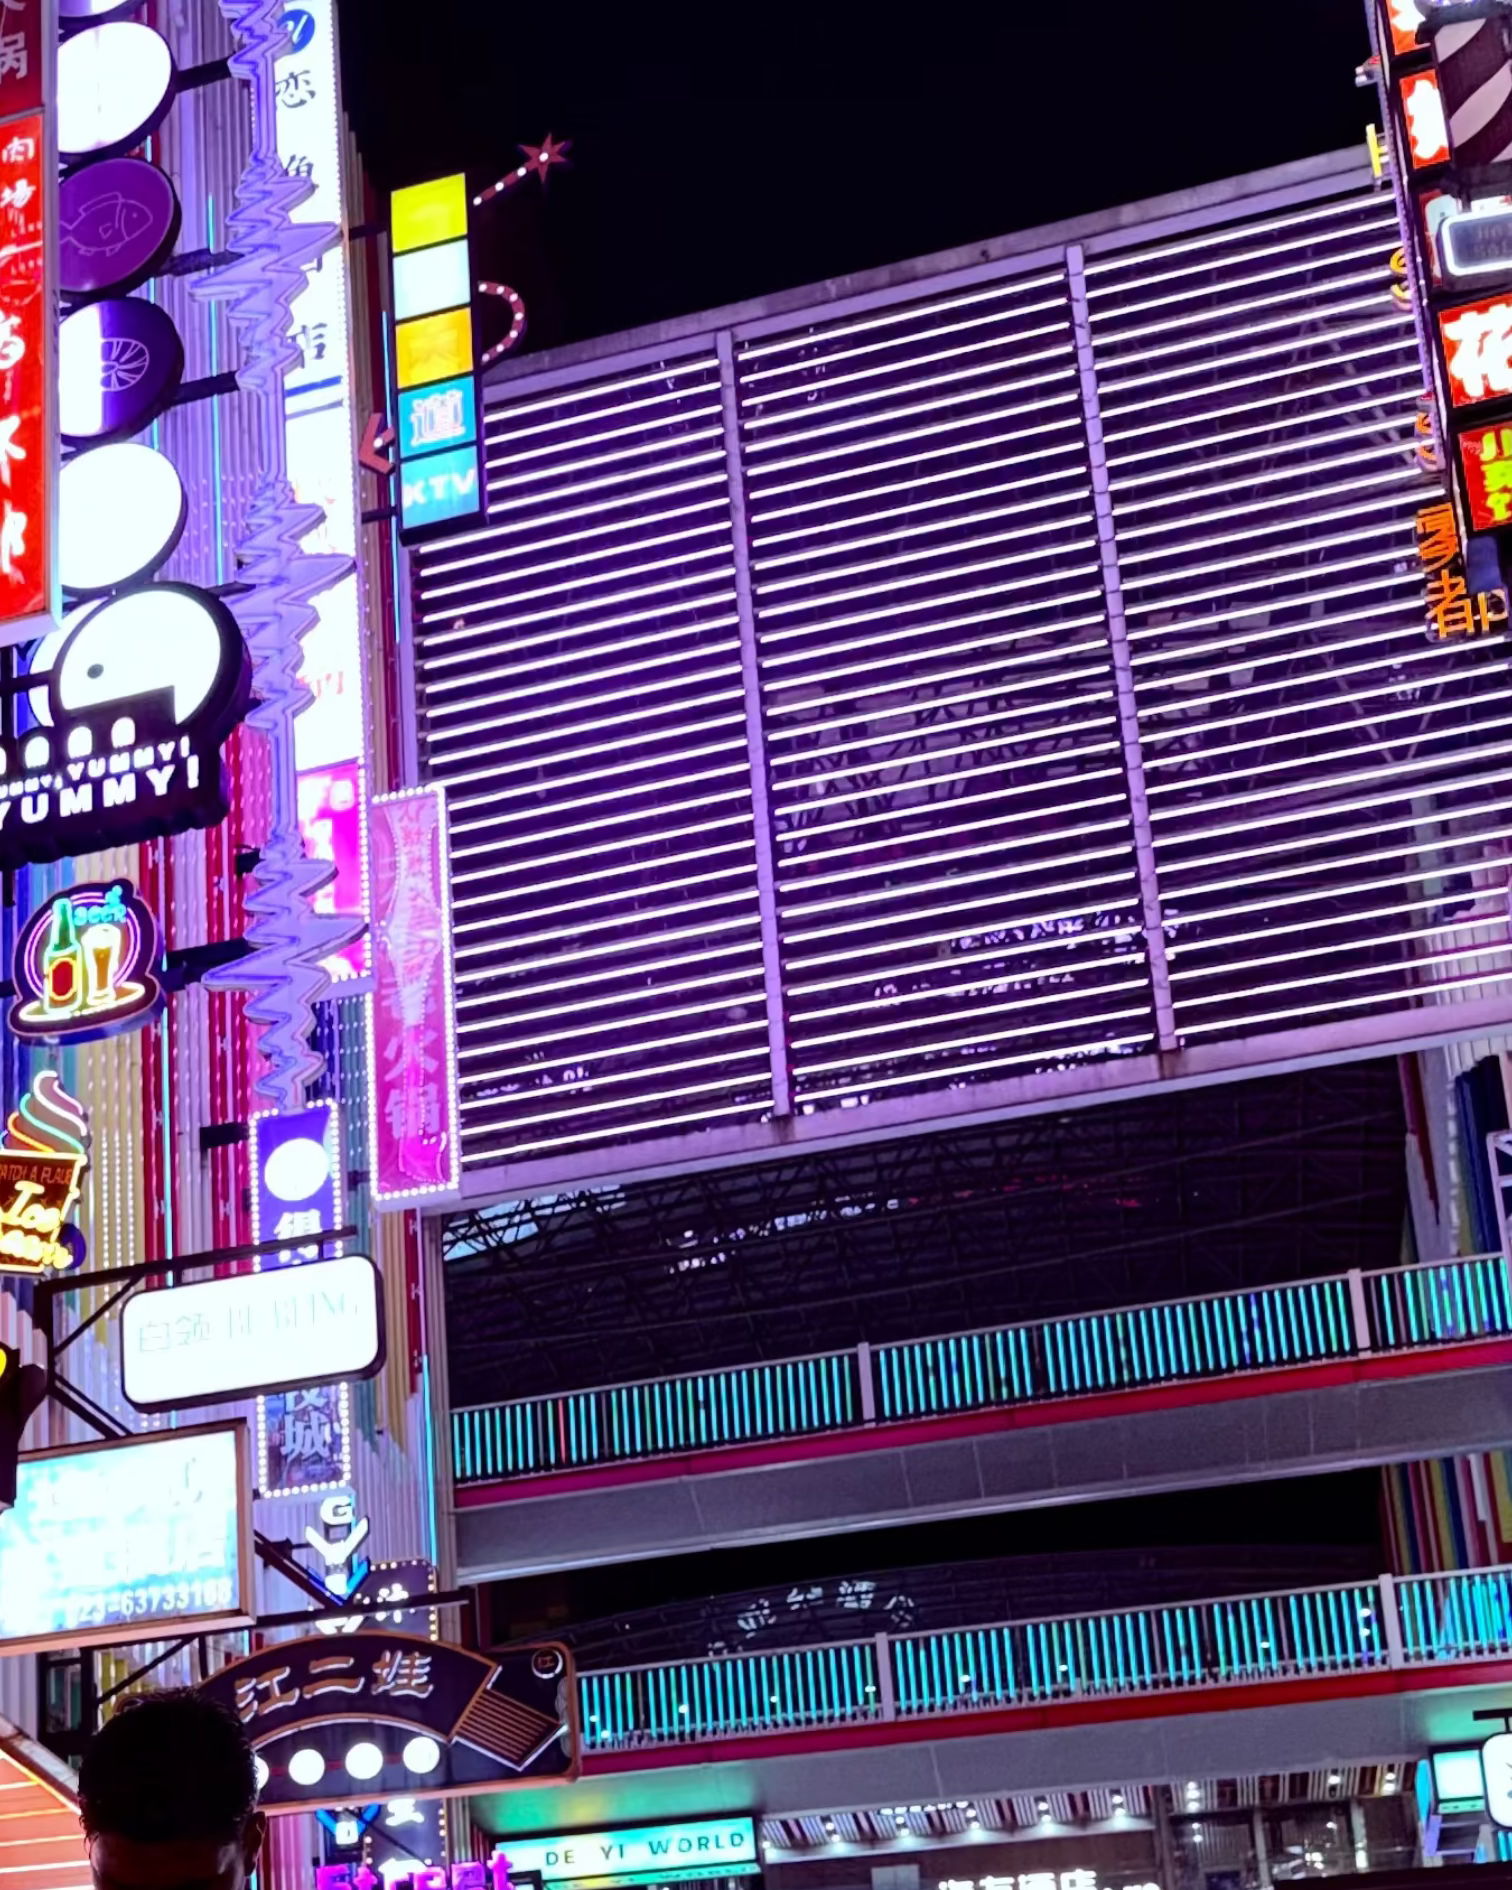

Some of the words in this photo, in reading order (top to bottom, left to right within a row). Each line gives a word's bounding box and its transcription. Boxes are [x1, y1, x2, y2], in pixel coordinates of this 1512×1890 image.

[402, 470, 476, 506] KTV
[67, 735, 190, 781] YUMMY!
[545, 1849, 575, 1867] DE
[600, 1843, 625, 1861] YI
[648, 1831, 745, 1856] WORLD
